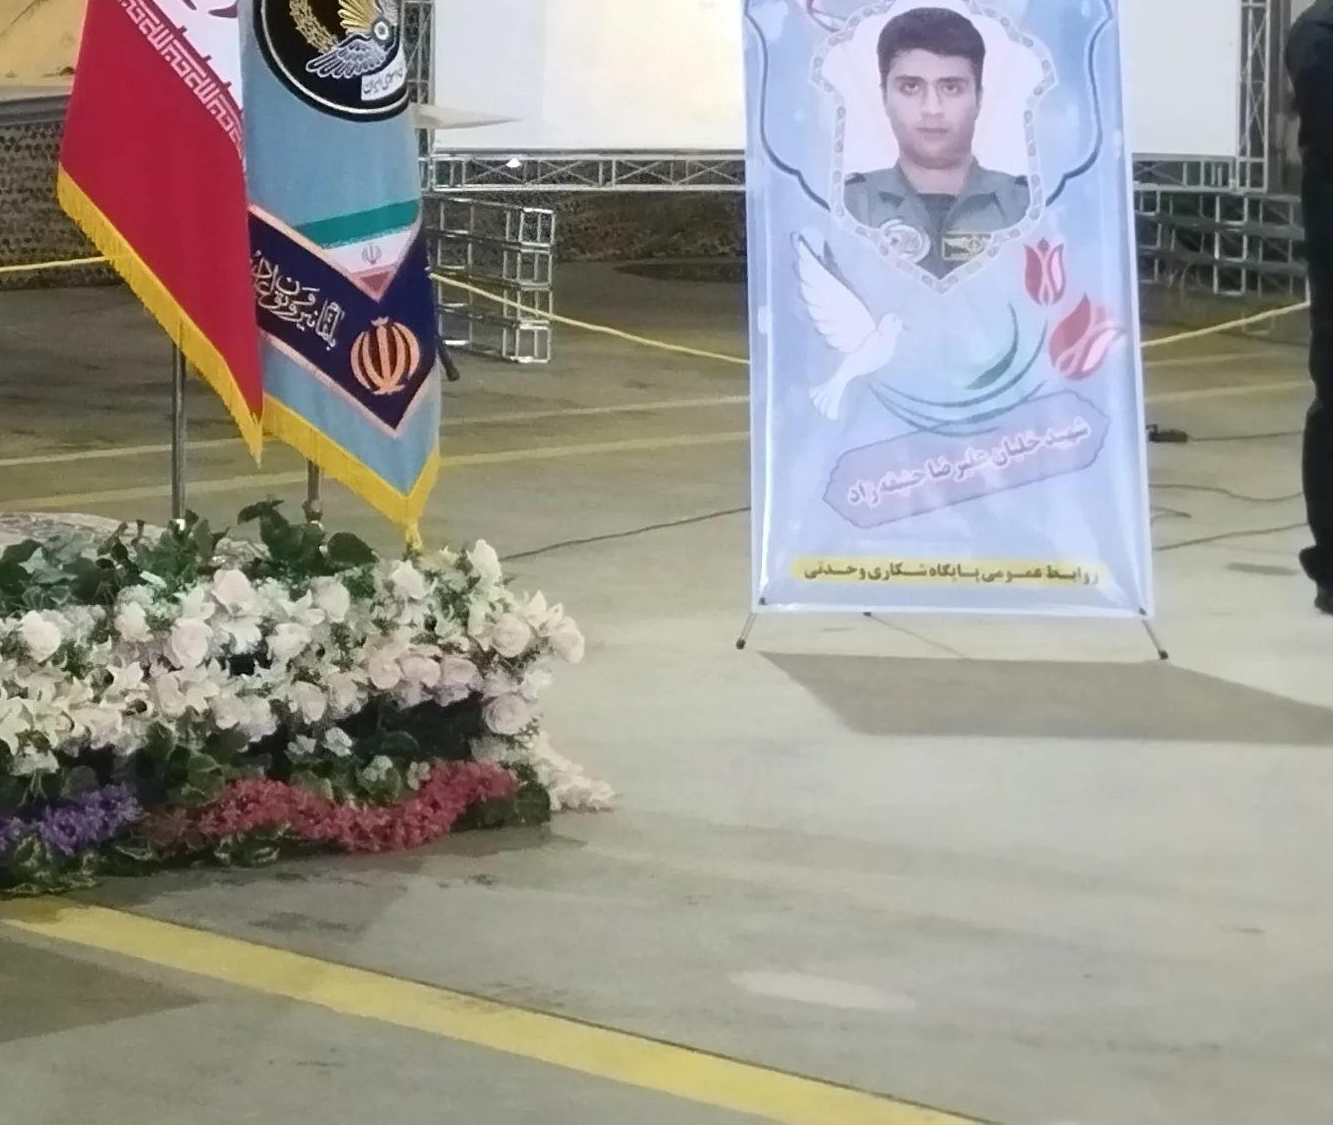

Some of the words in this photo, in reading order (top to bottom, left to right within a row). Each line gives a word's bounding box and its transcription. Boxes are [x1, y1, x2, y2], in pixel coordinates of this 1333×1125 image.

[1044, 419, 1090, 448] شهید
[925, 448, 991, 480] علیرضا
[992, 433, 1042, 468] خلبان
[867, 562, 927, 581] شکاری
[1044, 565, 1098, 585] روابط
